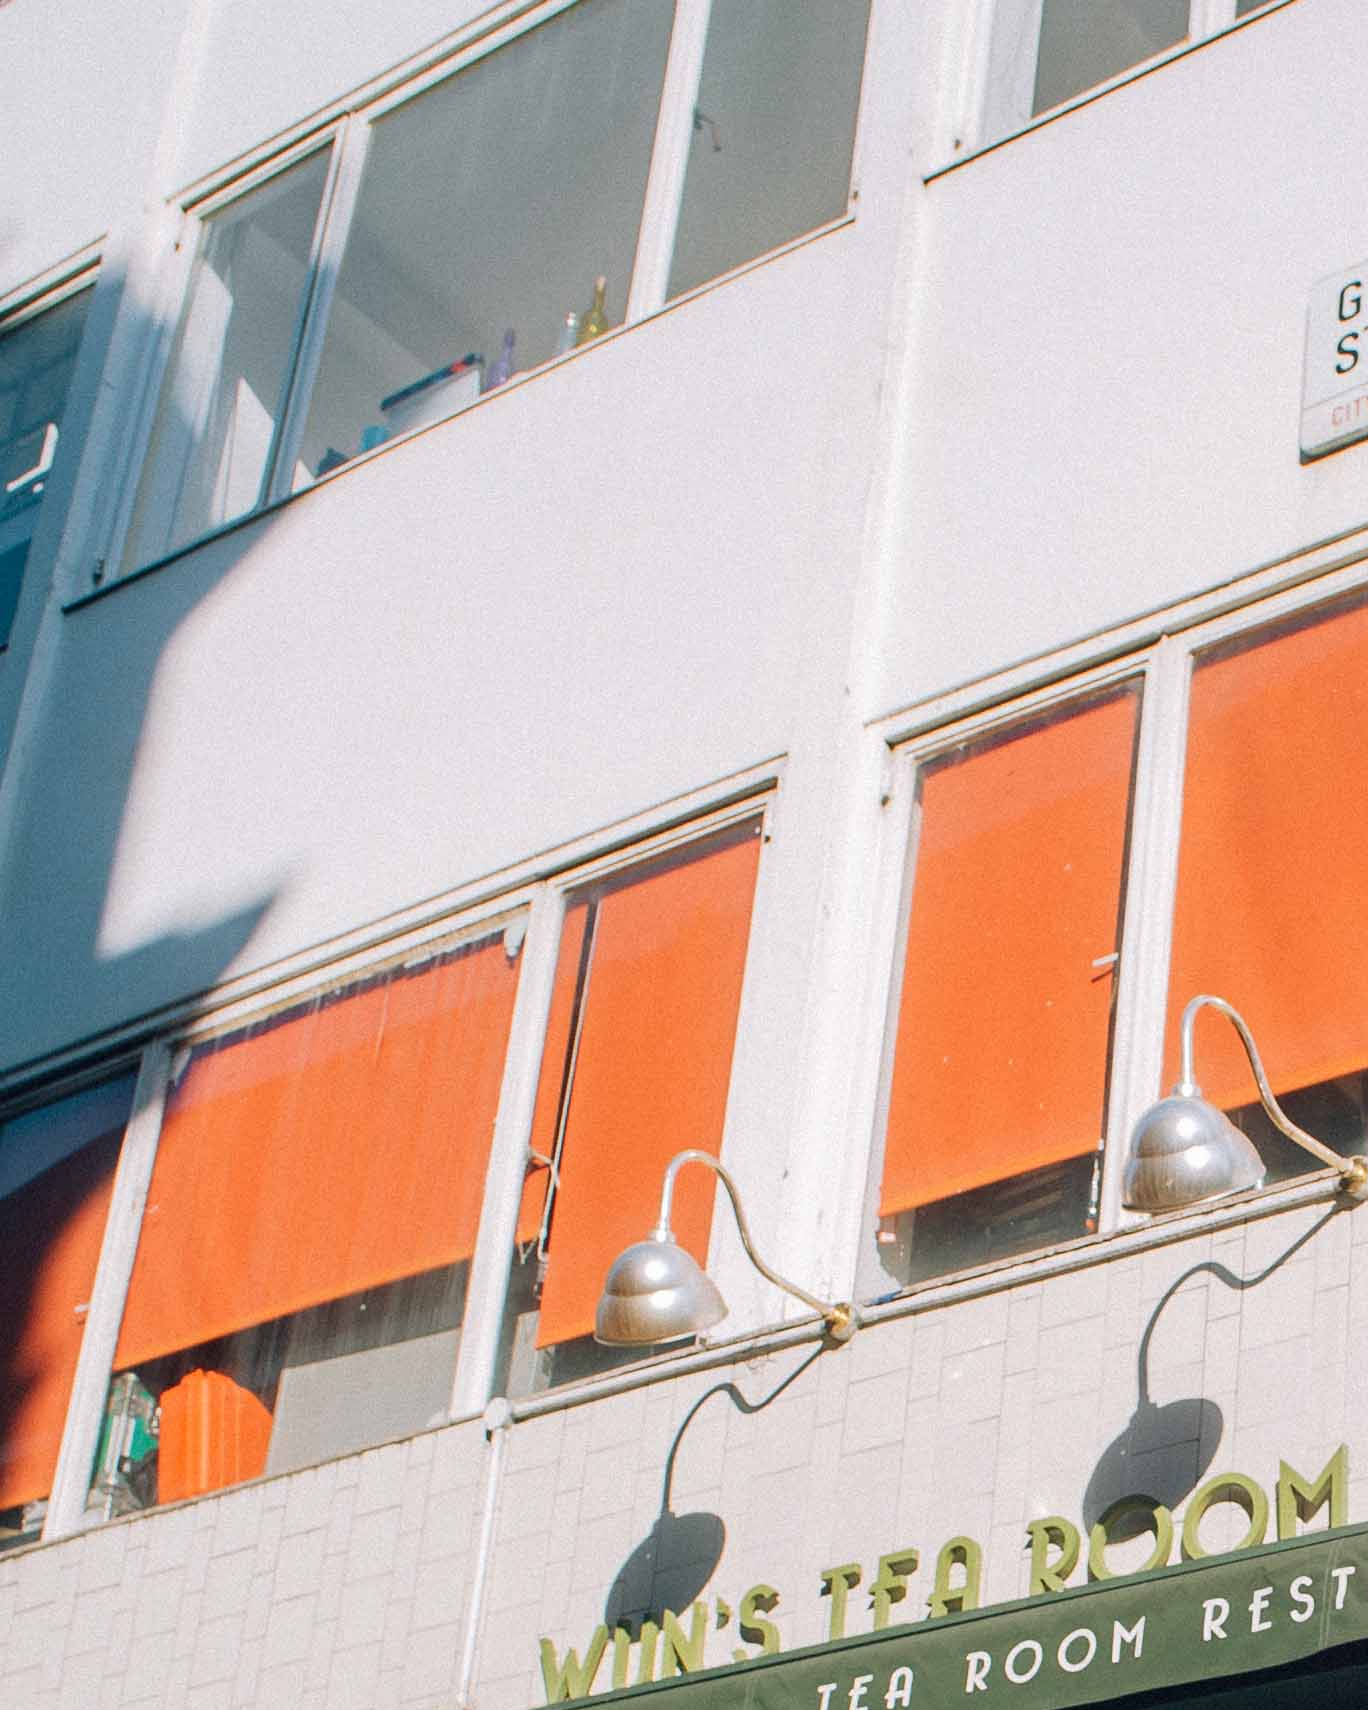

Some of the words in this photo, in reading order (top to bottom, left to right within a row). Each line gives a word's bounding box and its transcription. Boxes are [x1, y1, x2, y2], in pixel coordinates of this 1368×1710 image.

[821, 1535, 983, 1640] TEA
[1025, 1442, 1350, 1595] ROOM
[965, 1615, 1147, 1694] ROOM
